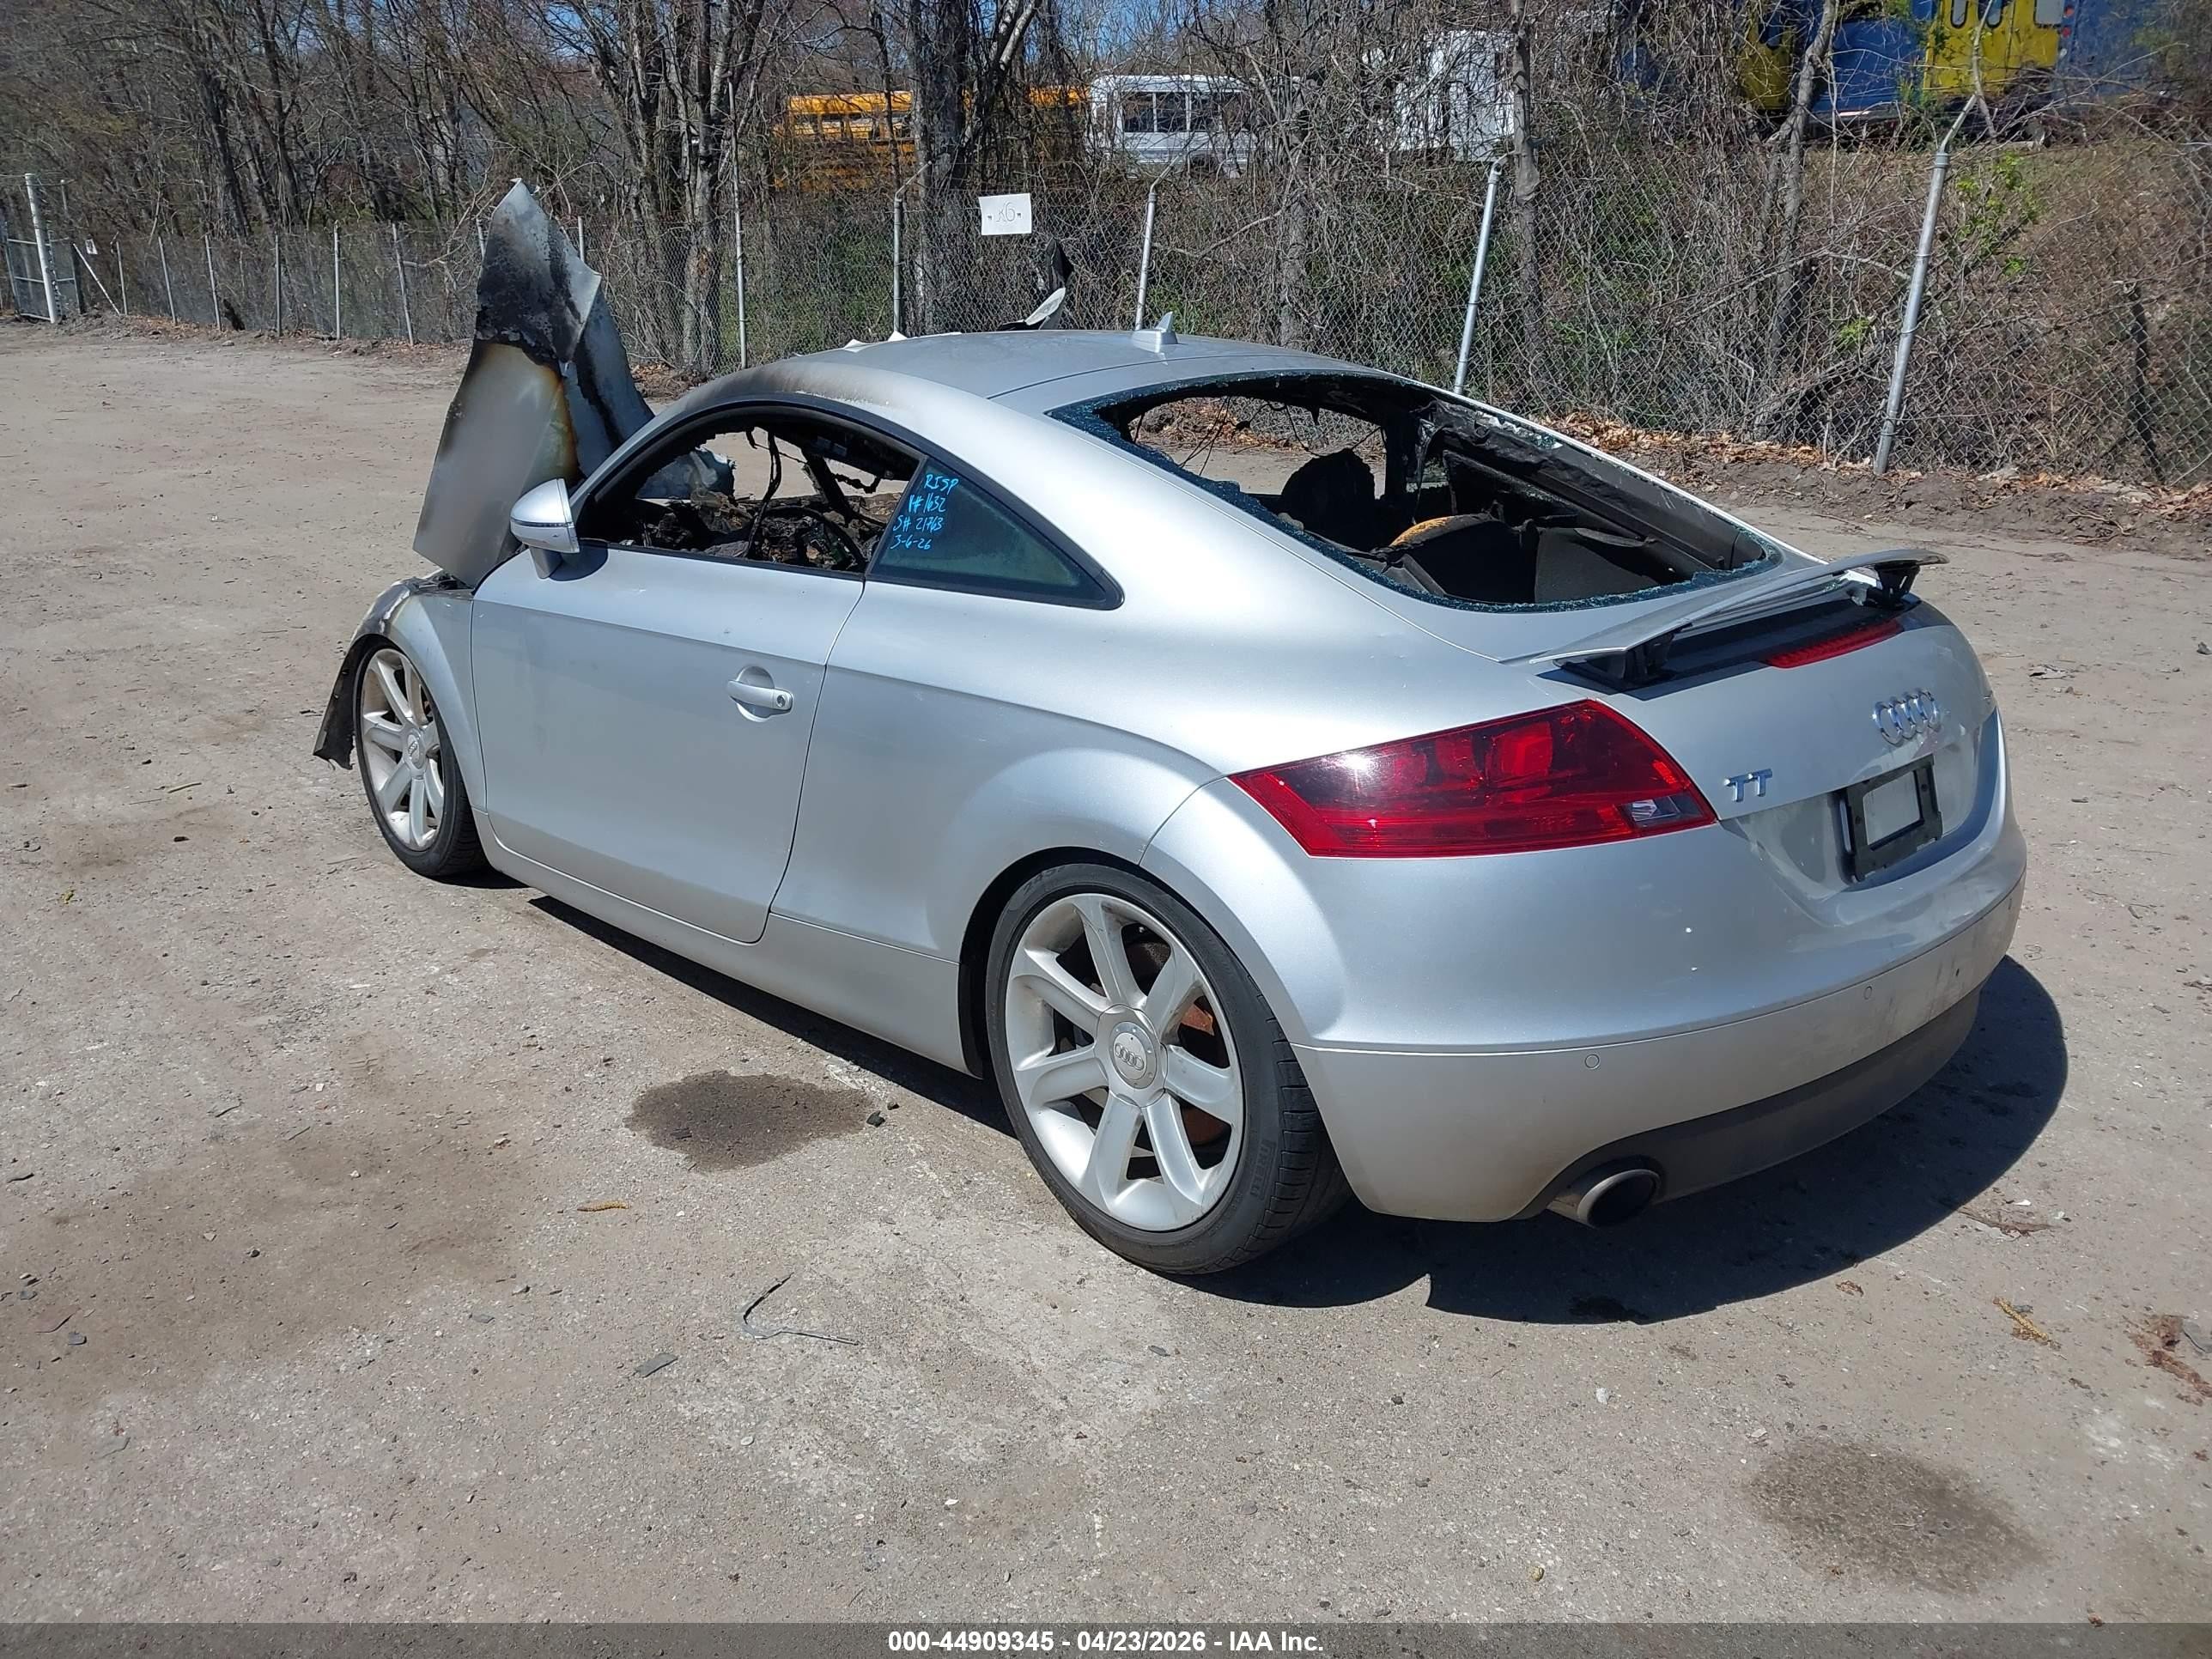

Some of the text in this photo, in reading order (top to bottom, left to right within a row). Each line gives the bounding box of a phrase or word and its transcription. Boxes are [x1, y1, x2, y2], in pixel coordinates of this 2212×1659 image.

[923, 493, 946, 514] 1632
[890, 534, 932, 550] 3-6-26
[1724, 769, 1772, 802] TT
